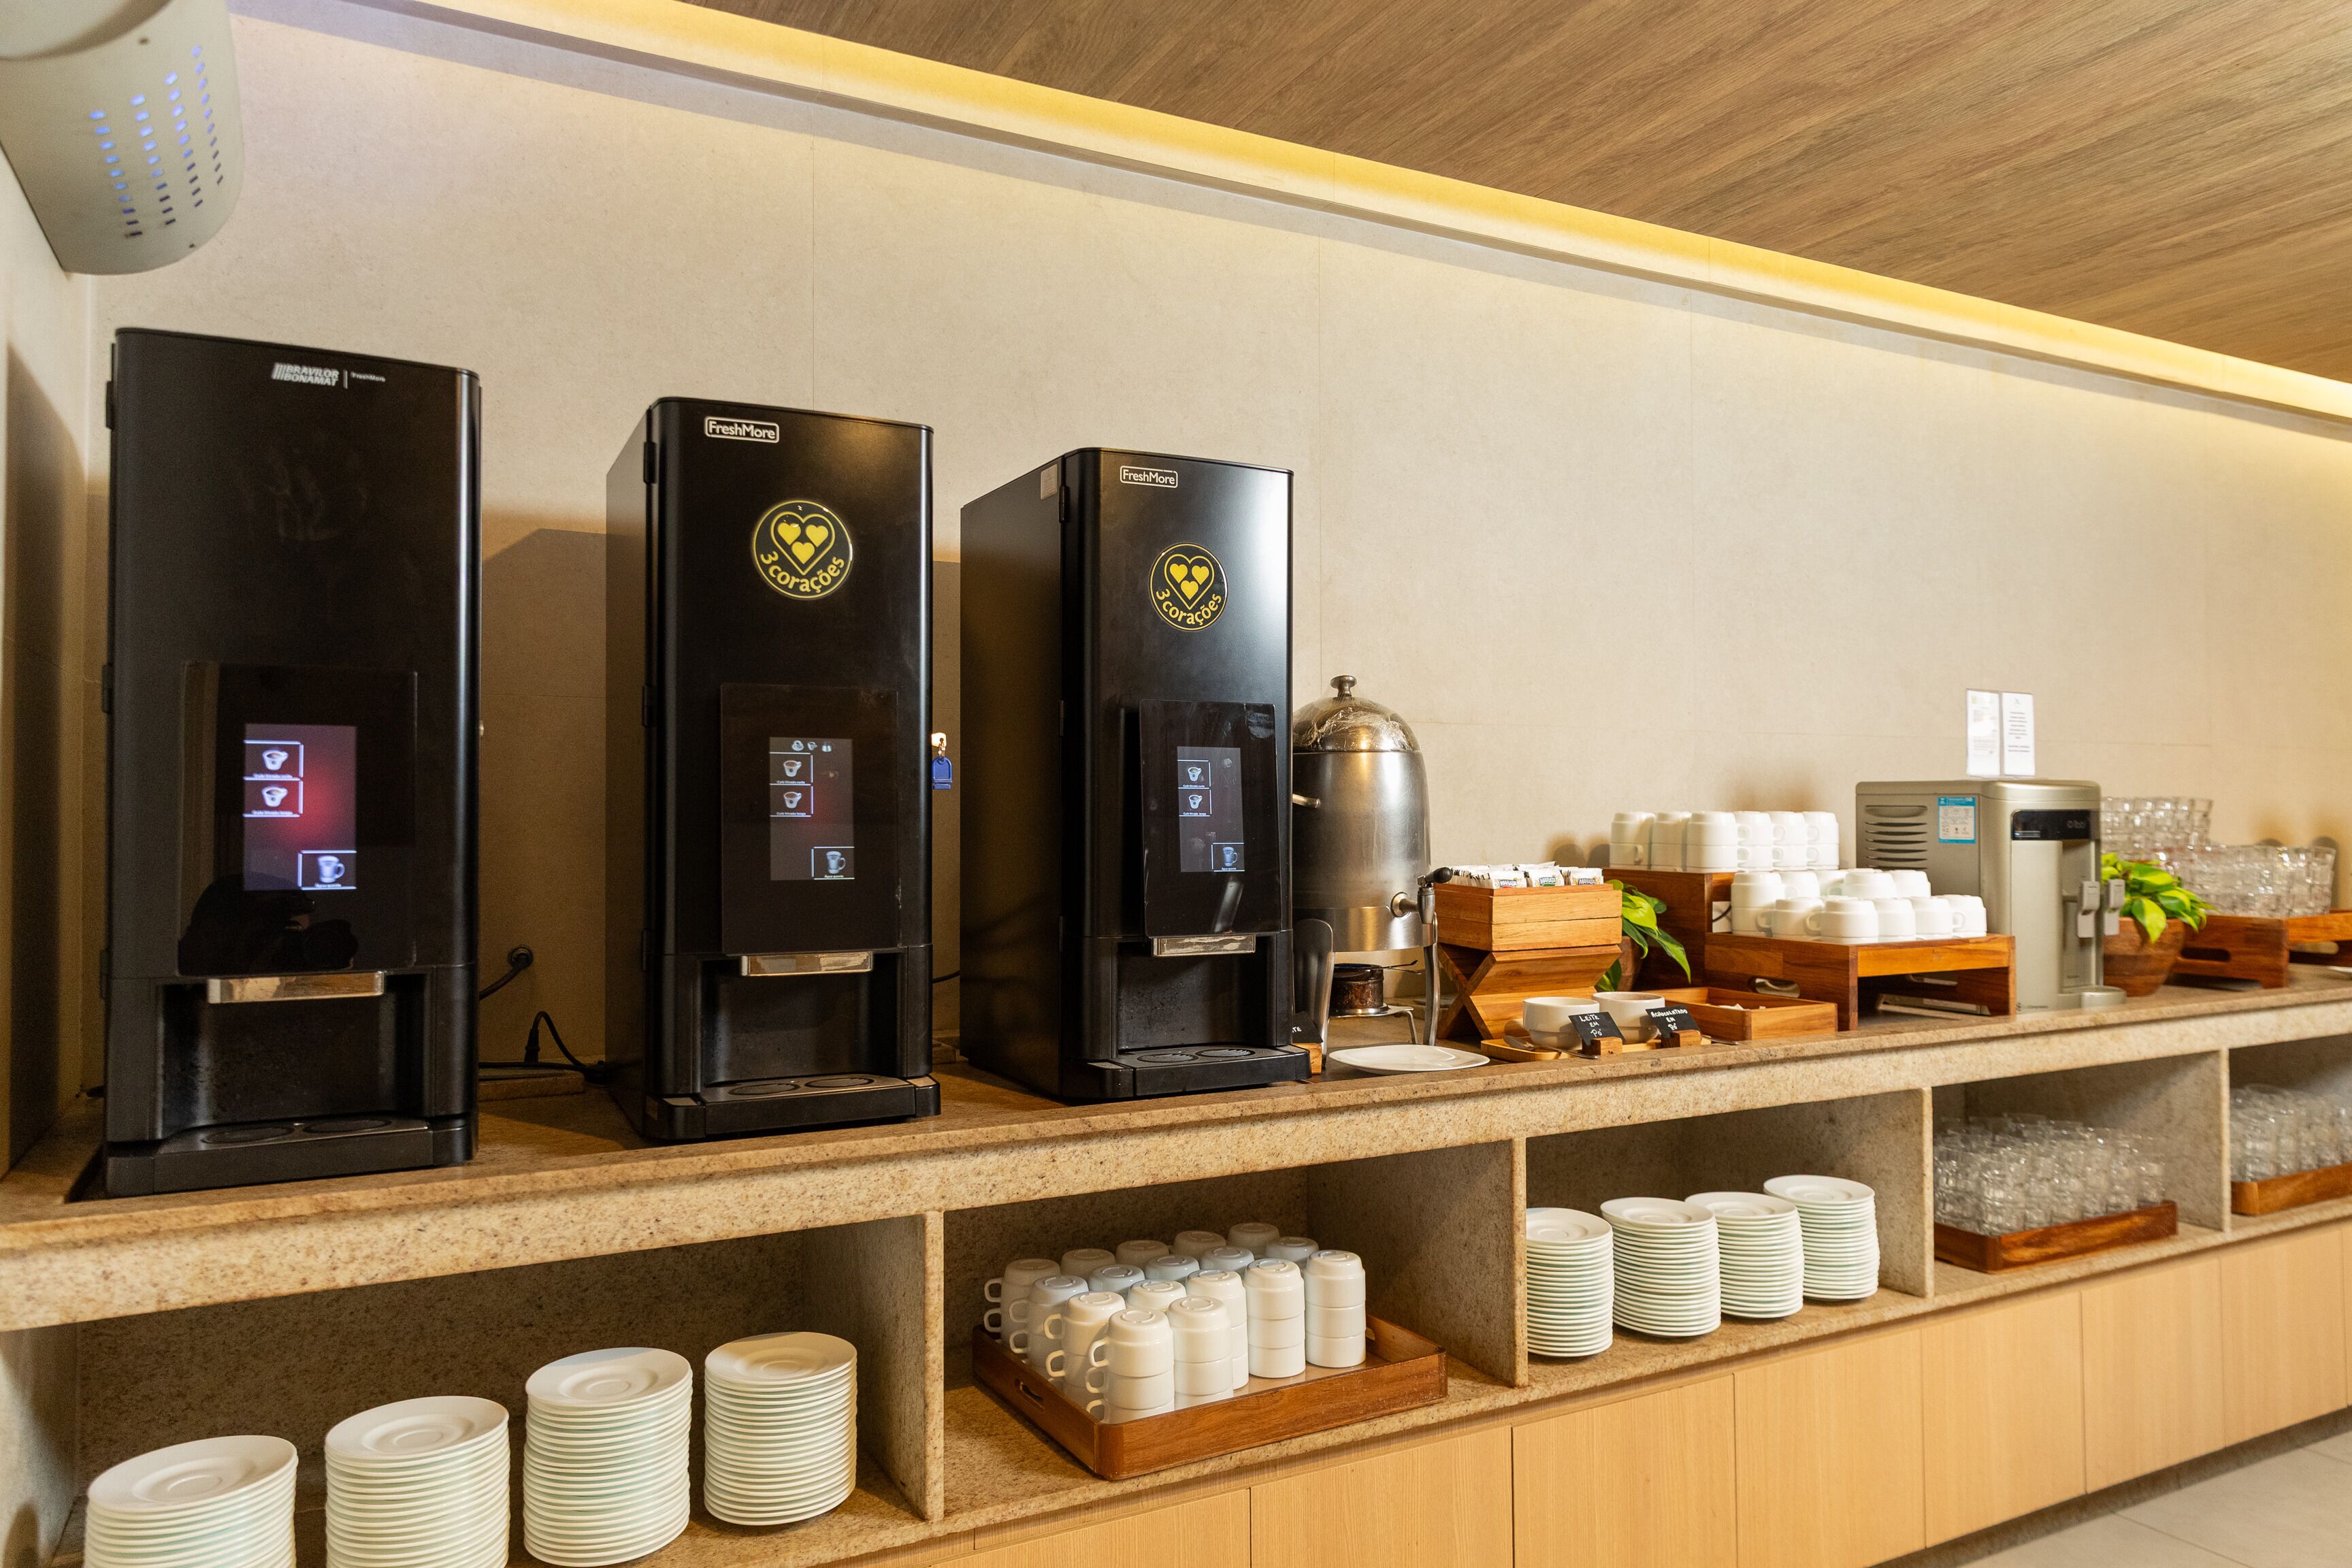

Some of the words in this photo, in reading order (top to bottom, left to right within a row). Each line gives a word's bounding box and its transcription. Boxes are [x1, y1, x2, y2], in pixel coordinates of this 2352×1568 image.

[286, 365, 339, 379] BRAVILOR
[284, 374, 338, 386] BONAMAT
[708, 420, 775, 439] FreshMore
[1123, 469, 1175, 485] FreshMore
[760, 551, 779, 564] 3
[768, 557, 845, 593] corações
[1156, 589, 1171, 600] 3
[1162, 593, 1222, 625] corações
